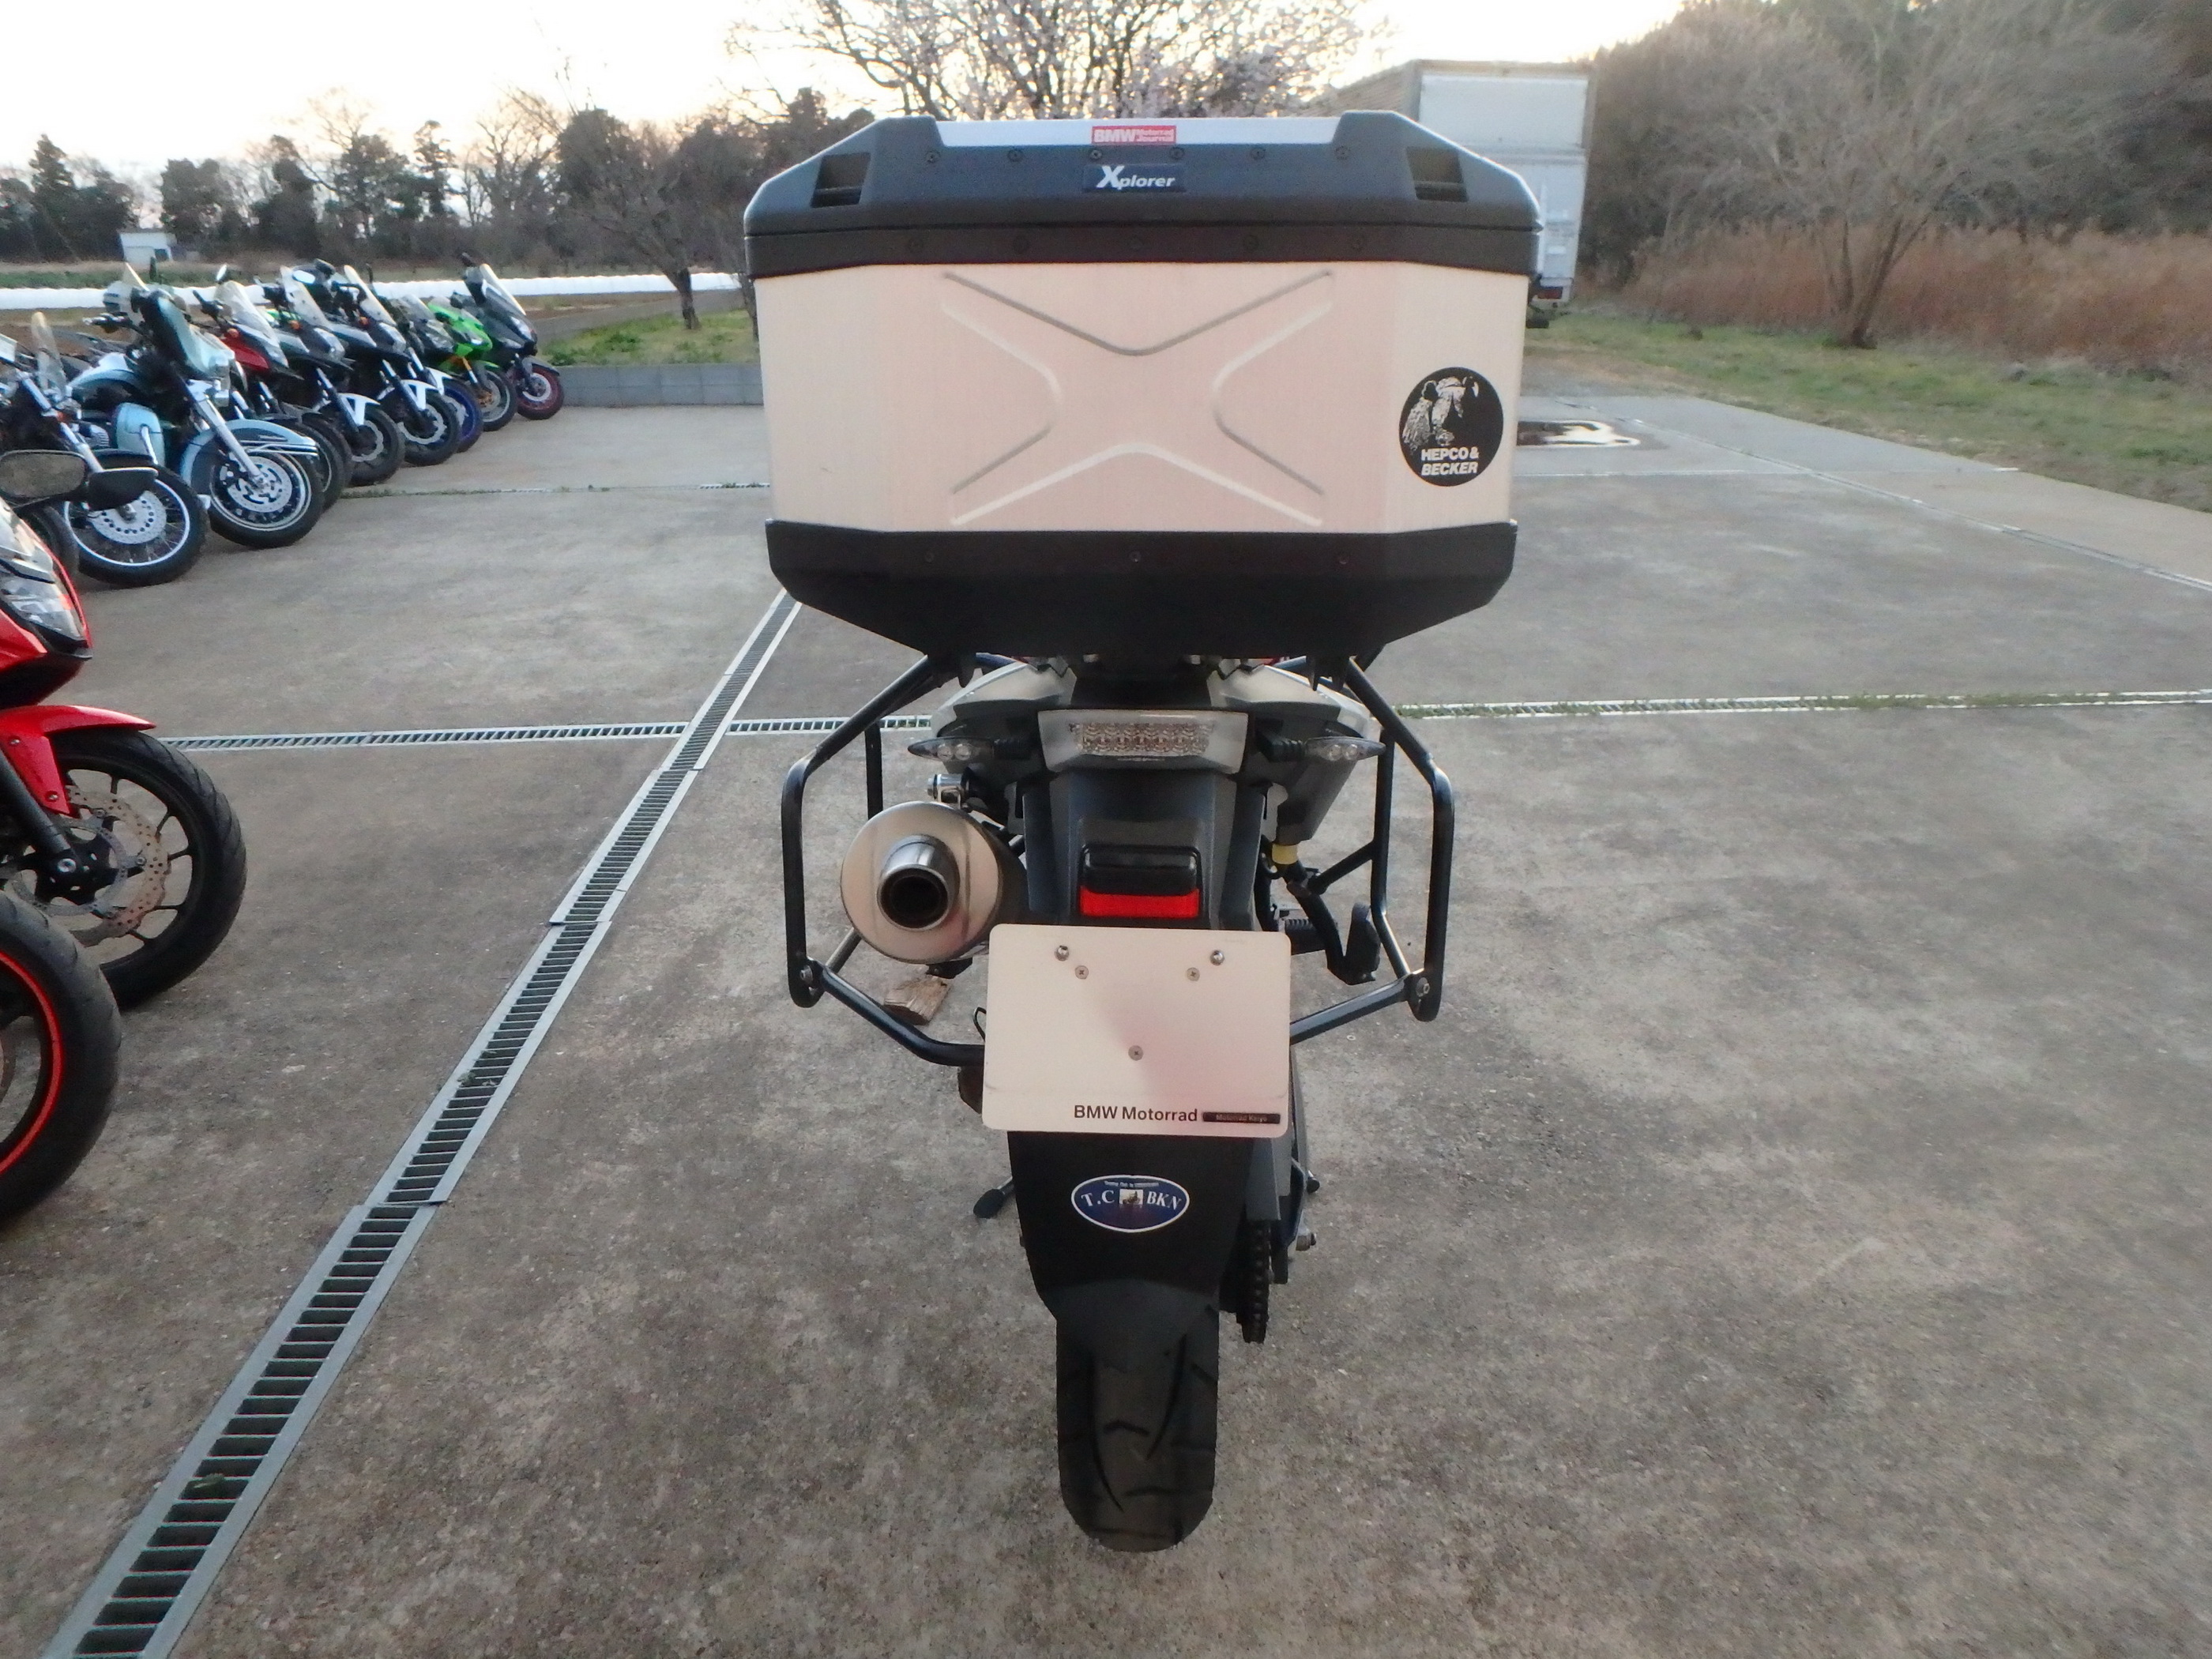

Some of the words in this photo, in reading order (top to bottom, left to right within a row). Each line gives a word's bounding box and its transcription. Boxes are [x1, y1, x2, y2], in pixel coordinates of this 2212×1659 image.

[1094, 129, 1135, 142] BMW
[1096, 165, 1176, 190] Xplorer
[1421, 447, 1469, 461] HEPCO
[1469, 446, 1479, 459] &
[1421, 461, 1478, 476] BECKER
[1074, 1105, 1118, 1119] BMW
[1122, 1106, 1198, 1122] Motorrad
[1081, 1190, 1114, 1207] T.C
[1146, 1191, 1182, 1210] BKN
